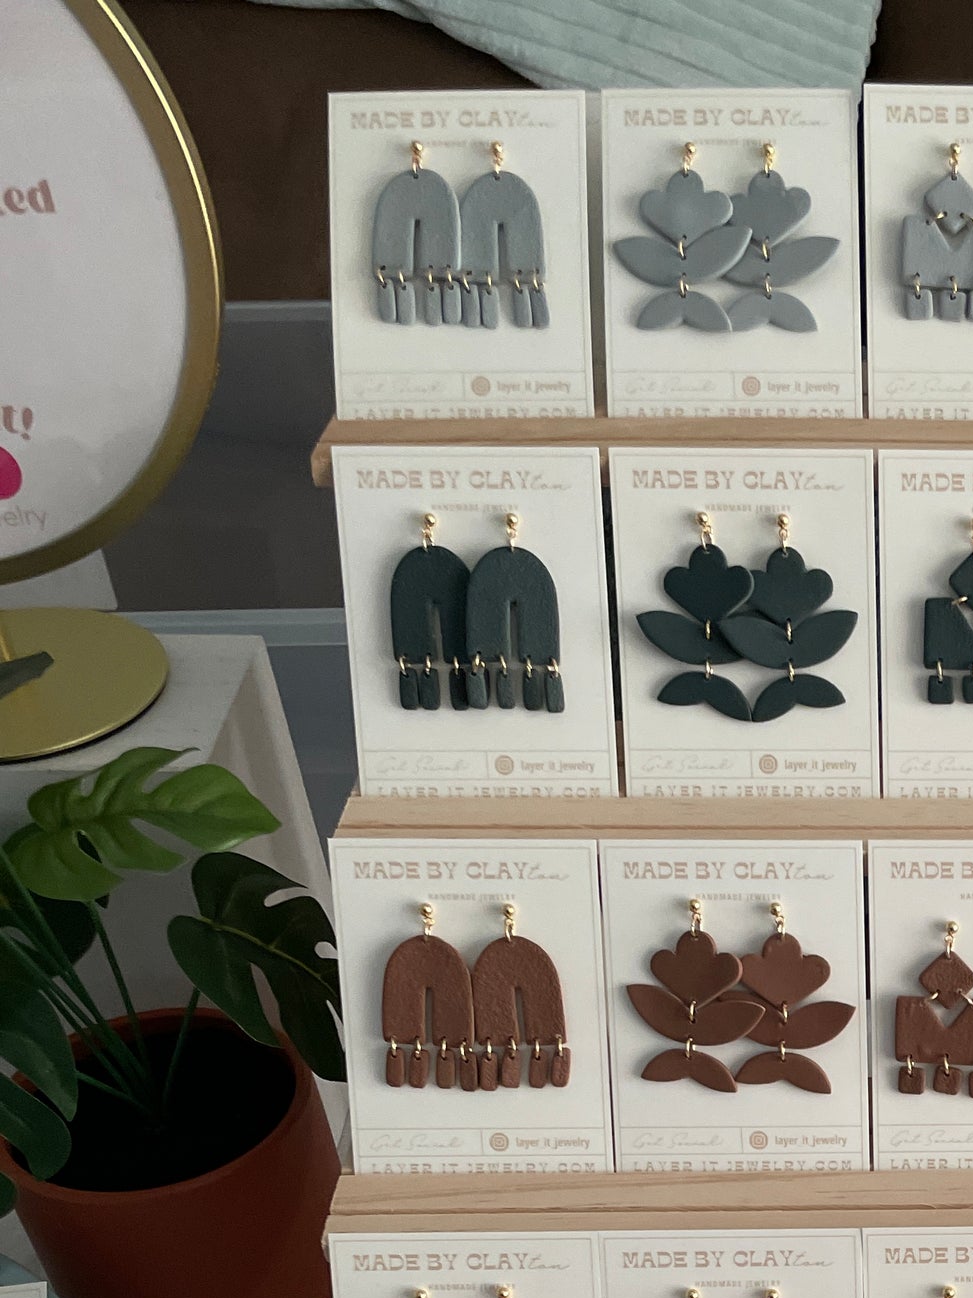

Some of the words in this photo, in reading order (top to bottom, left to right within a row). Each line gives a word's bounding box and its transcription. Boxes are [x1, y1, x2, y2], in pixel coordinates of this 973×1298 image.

[350, 110, 414, 129] MADE
[417, 110, 450, 128] BY
[624, 109, 687, 127] MADE
[693, 109, 724, 126] BY
[886, 106, 949, 125] MADE
[0, 179, 56, 216] ed
[356, 470, 422, 489] MADE
[427, 470, 459, 489] BY
[632, 470, 698, 489] MADE
[704, 470, 735, 489] BY
[900, 472, 965, 492] MADE
[0, 505, 46, 530] elry
[353, 861, 420, 880] MADE
[427, 861, 457, 880] BY
[623, 861, 690, 880] MADE
[696, 861, 727, 880] BY
[890, 861, 955, 880] MADE
[353, 1253, 421, 1271] MADE
[427, 1253, 459, 1270] BY
[622, 1250, 688, 1269] MADE
[694, 1250, 725, 1268] BY
[885, 1247, 950, 1264] MADE
